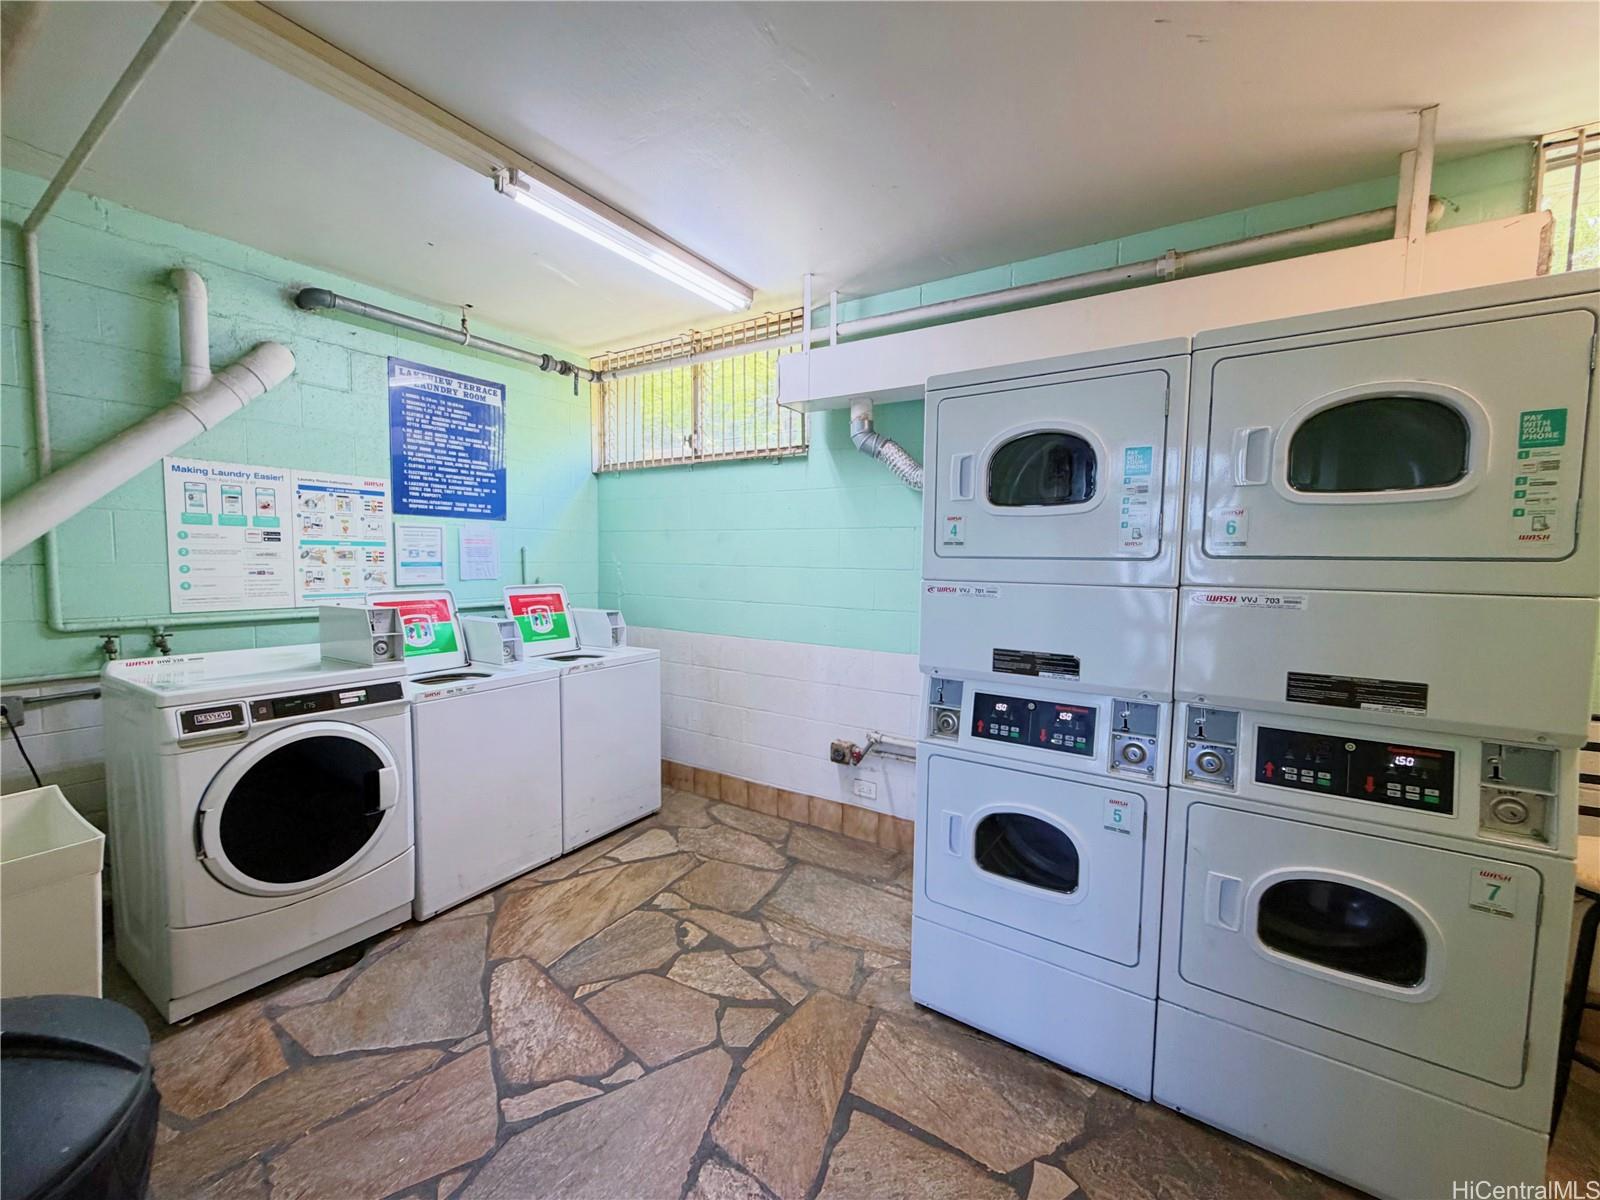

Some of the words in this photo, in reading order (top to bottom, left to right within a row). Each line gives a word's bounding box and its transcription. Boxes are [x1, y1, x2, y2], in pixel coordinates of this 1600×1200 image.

[457, 381, 498, 397] TERRACE
[463, 391, 487, 403] ROOM
[1522, 420, 1551, 429] WITH
[1523, 414, 1544, 423] PAY
[1522, 426, 1551, 435] YOUR
[1522, 431, 1560, 440] PHONE
[171, 465, 209, 477] Making
[211, 468, 251, 479] Laundry
[254, 472, 284, 481] Easier!
[950, 523, 958, 537] 4
[1226, 520, 1237, 536] 6
[1205, 594, 1237, 603] WASH
[1240, 596, 1258, 604] VVJ
[1264, 597, 1280, 605] 703
[197, 710, 231, 722] MAYTAG
[1113, 808, 1122, 823] 5
[1487, 883, 1502, 901] 7
